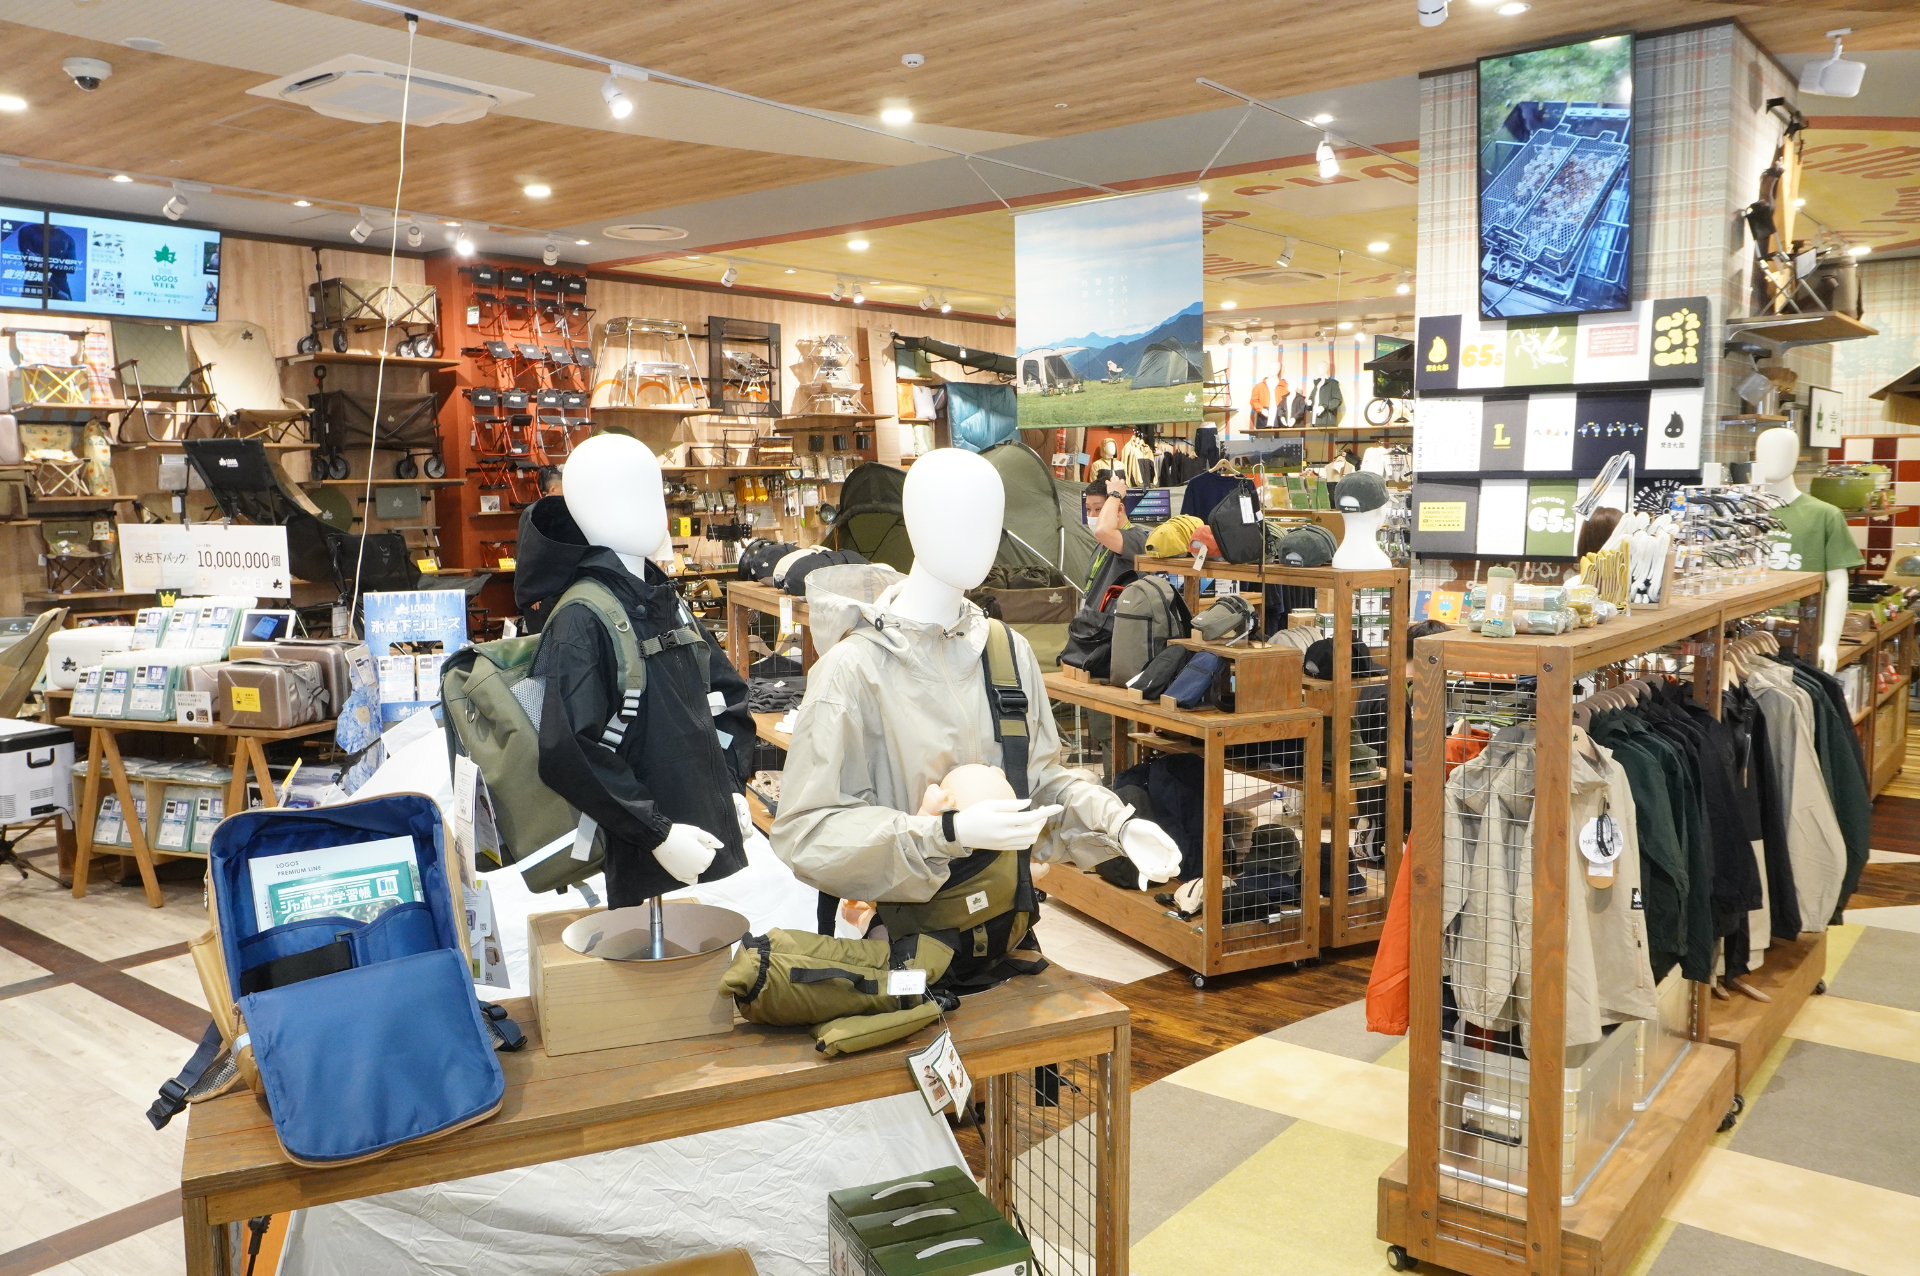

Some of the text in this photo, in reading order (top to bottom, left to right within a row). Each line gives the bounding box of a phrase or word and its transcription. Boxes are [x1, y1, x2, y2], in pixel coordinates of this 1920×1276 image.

[152, 275, 178, 283] LOGOS
[1461, 344, 1503, 367] 65s
[1493, 423, 1511, 446] L
[1654, 479, 1682, 489] NEVE
[1531, 496, 1566, 505] OUTDOOR
[1528, 507, 1575, 533] 65s
[134, 552, 187, 564] 氷点下パック
[1768, 542, 1803, 570] 5s
[410, 603, 436, 613] LOGOS
[370, 617, 461, 633] 氷点下シリーズ
[276, 860, 299, 869] LOGOS
[277, 865, 322, 877] PREMIUM LINE
[279, 886, 373, 915] ジャポニカ学習帳
